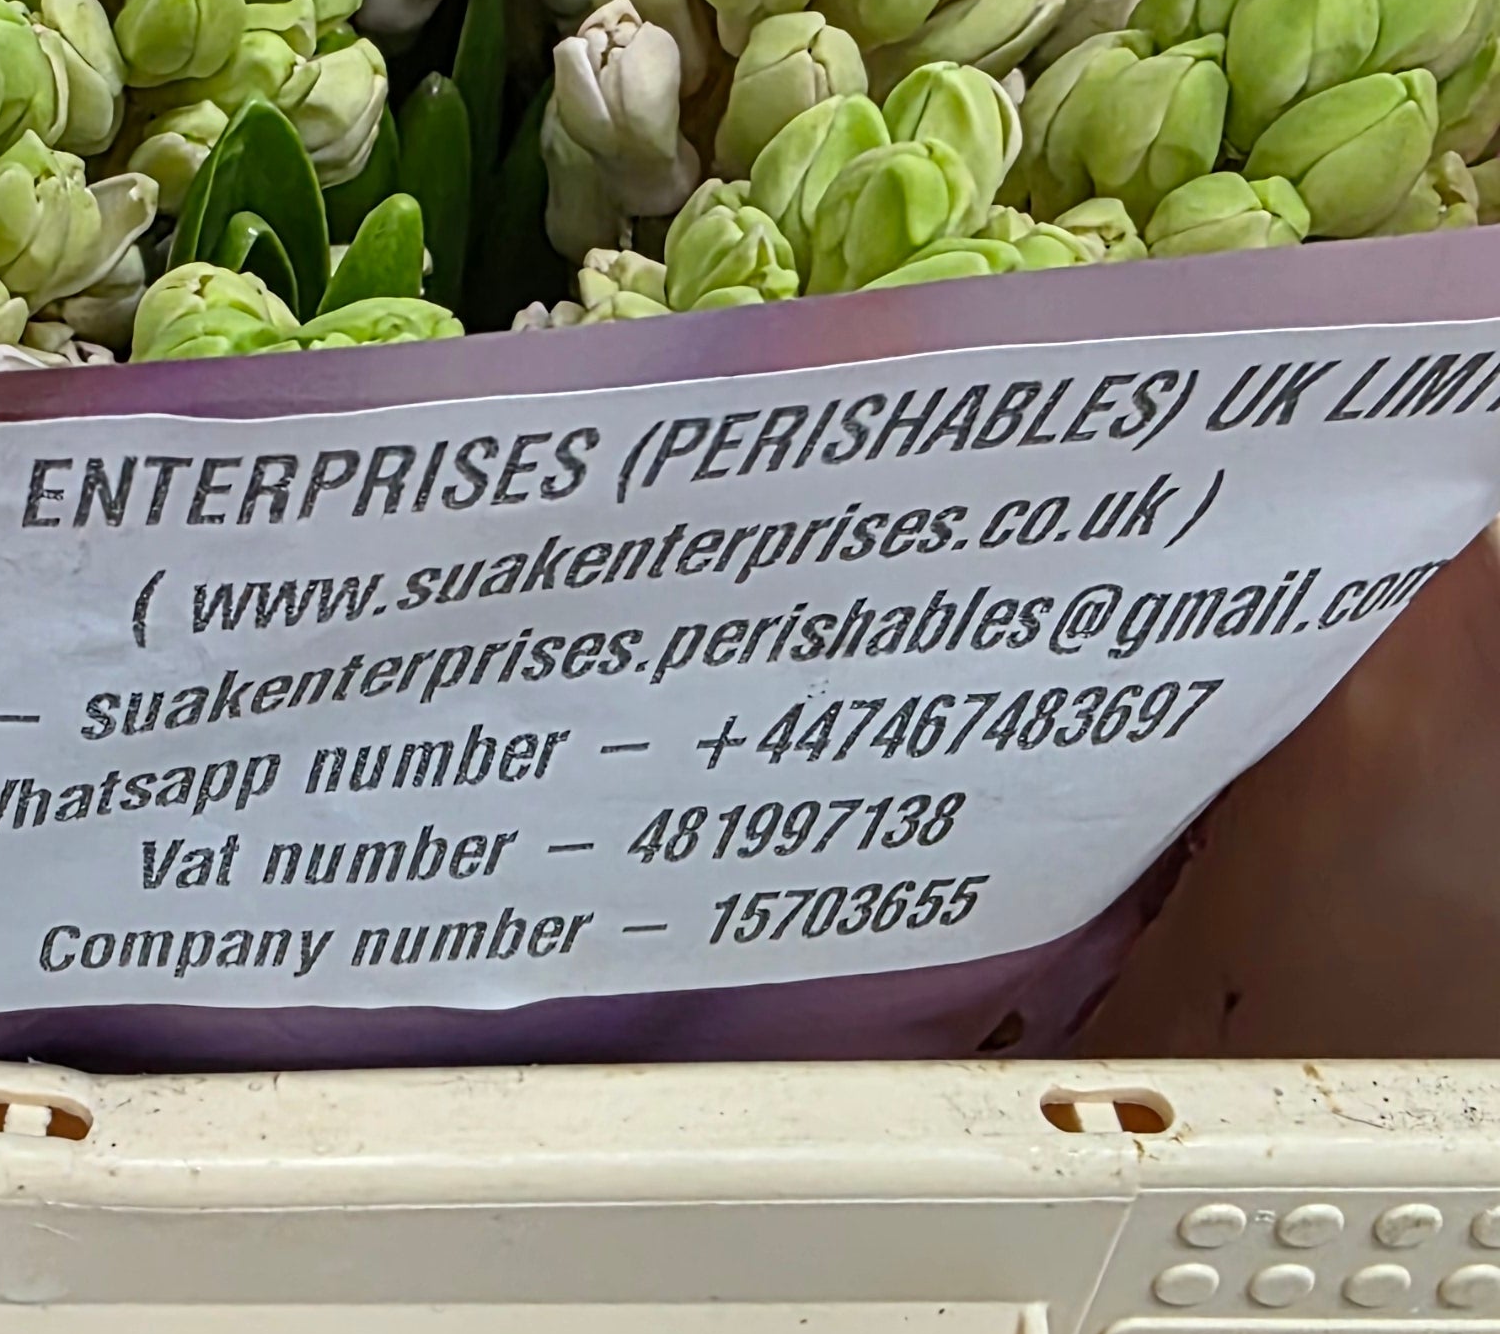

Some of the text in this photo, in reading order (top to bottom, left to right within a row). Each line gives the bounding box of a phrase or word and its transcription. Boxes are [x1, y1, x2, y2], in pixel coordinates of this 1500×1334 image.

[22, 428, 600, 528] ENTERPRISES
[617, 370, 1199, 503] (PERISHABLES)
[1206, 360, 1342, 431] UK
[1324, 351, 1500, 421] LIMI
[193, 473, 1180, 633] www.suakenterprises.co.uk
[305, 724, 571, 794] number
[696, 679, 1224, 769] +447467483697
[142, 834, 239, 889] Vat
[263, 825, 519, 885] number
[628, 792, 966, 863] 481997138
[39, 925, 334, 977] Company
[351, 907, 594, 966] number
[710, 875, 990, 944] 15703655
